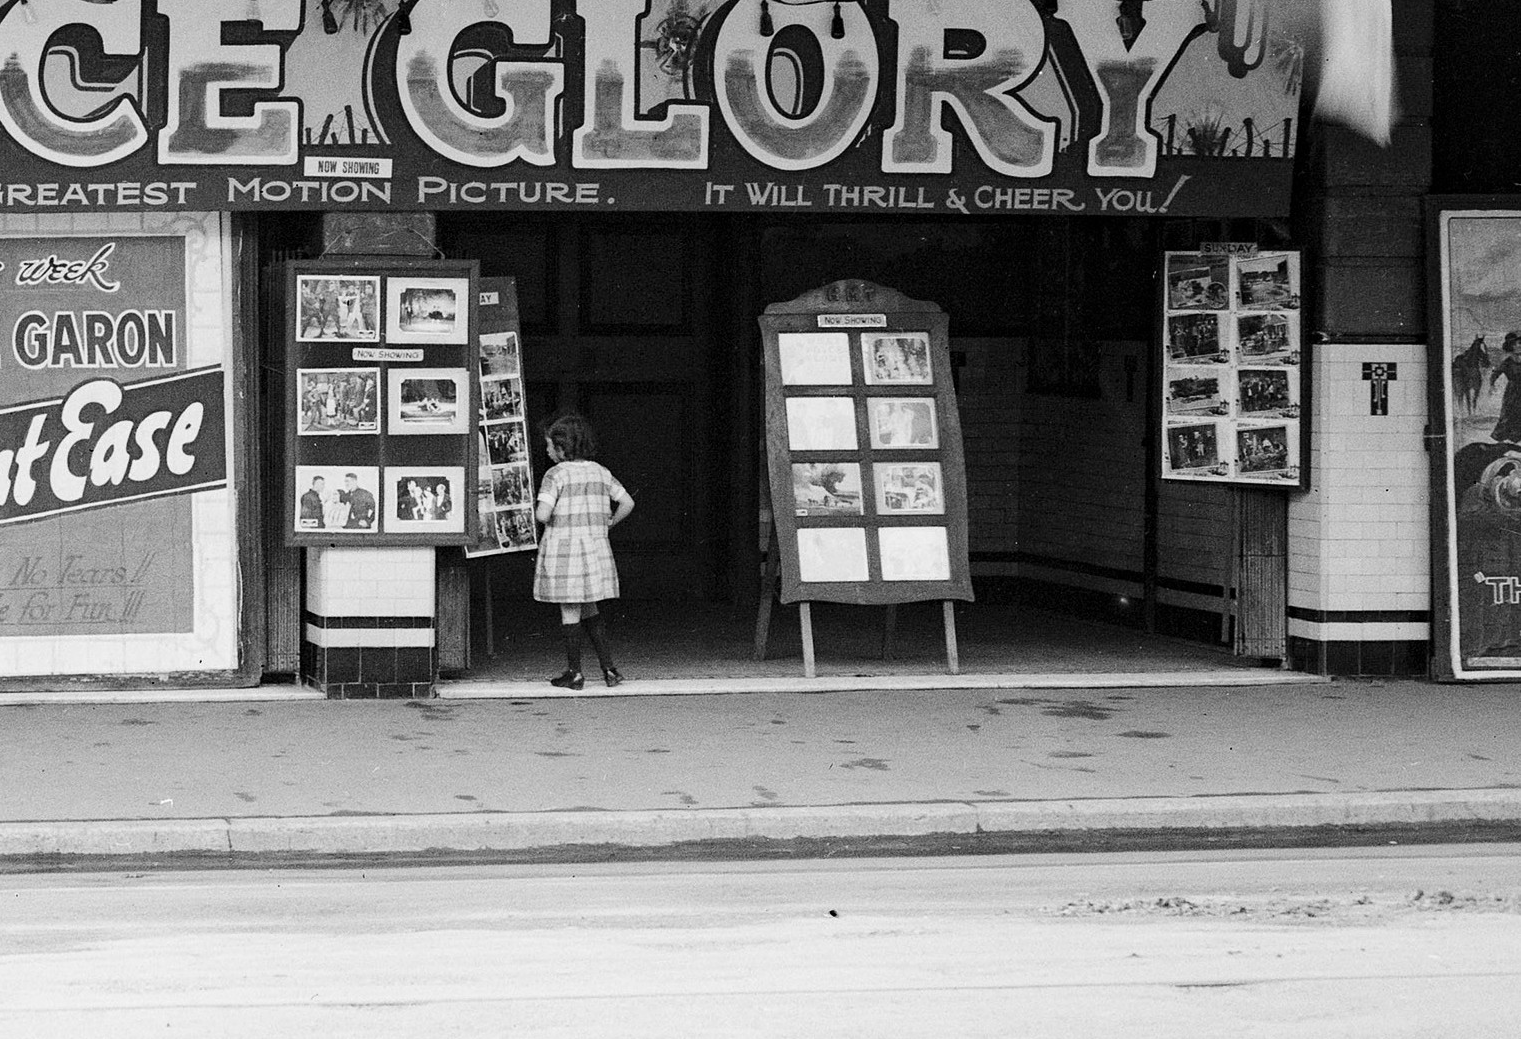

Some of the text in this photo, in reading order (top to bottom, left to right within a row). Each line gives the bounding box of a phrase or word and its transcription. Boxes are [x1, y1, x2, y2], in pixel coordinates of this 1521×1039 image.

[317, 160, 381, 176] NOW SHOWING
[226, 177, 392, 205] MOTION
[416, 176, 617, 206] PICTURE.
[704, 181, 735, 206] IT
[744, 182, 812, 208] WILL
[822, 183, 936, 209] THRILL
[945, 188, 971, 214] &
[974, 185, 1086, 211] CHEER
[1203, 243, 1253, 253] SUNDAY
[15, 242, 120, 293] week
[480, 294, 492, 303] AY
[824, 315, 882, 324] NOW SHOWING
[12, 308, 178, 371] GARON
[356, 350, 420, 359] NOW SHOWING
[49, 378, 206, 503] Ease
